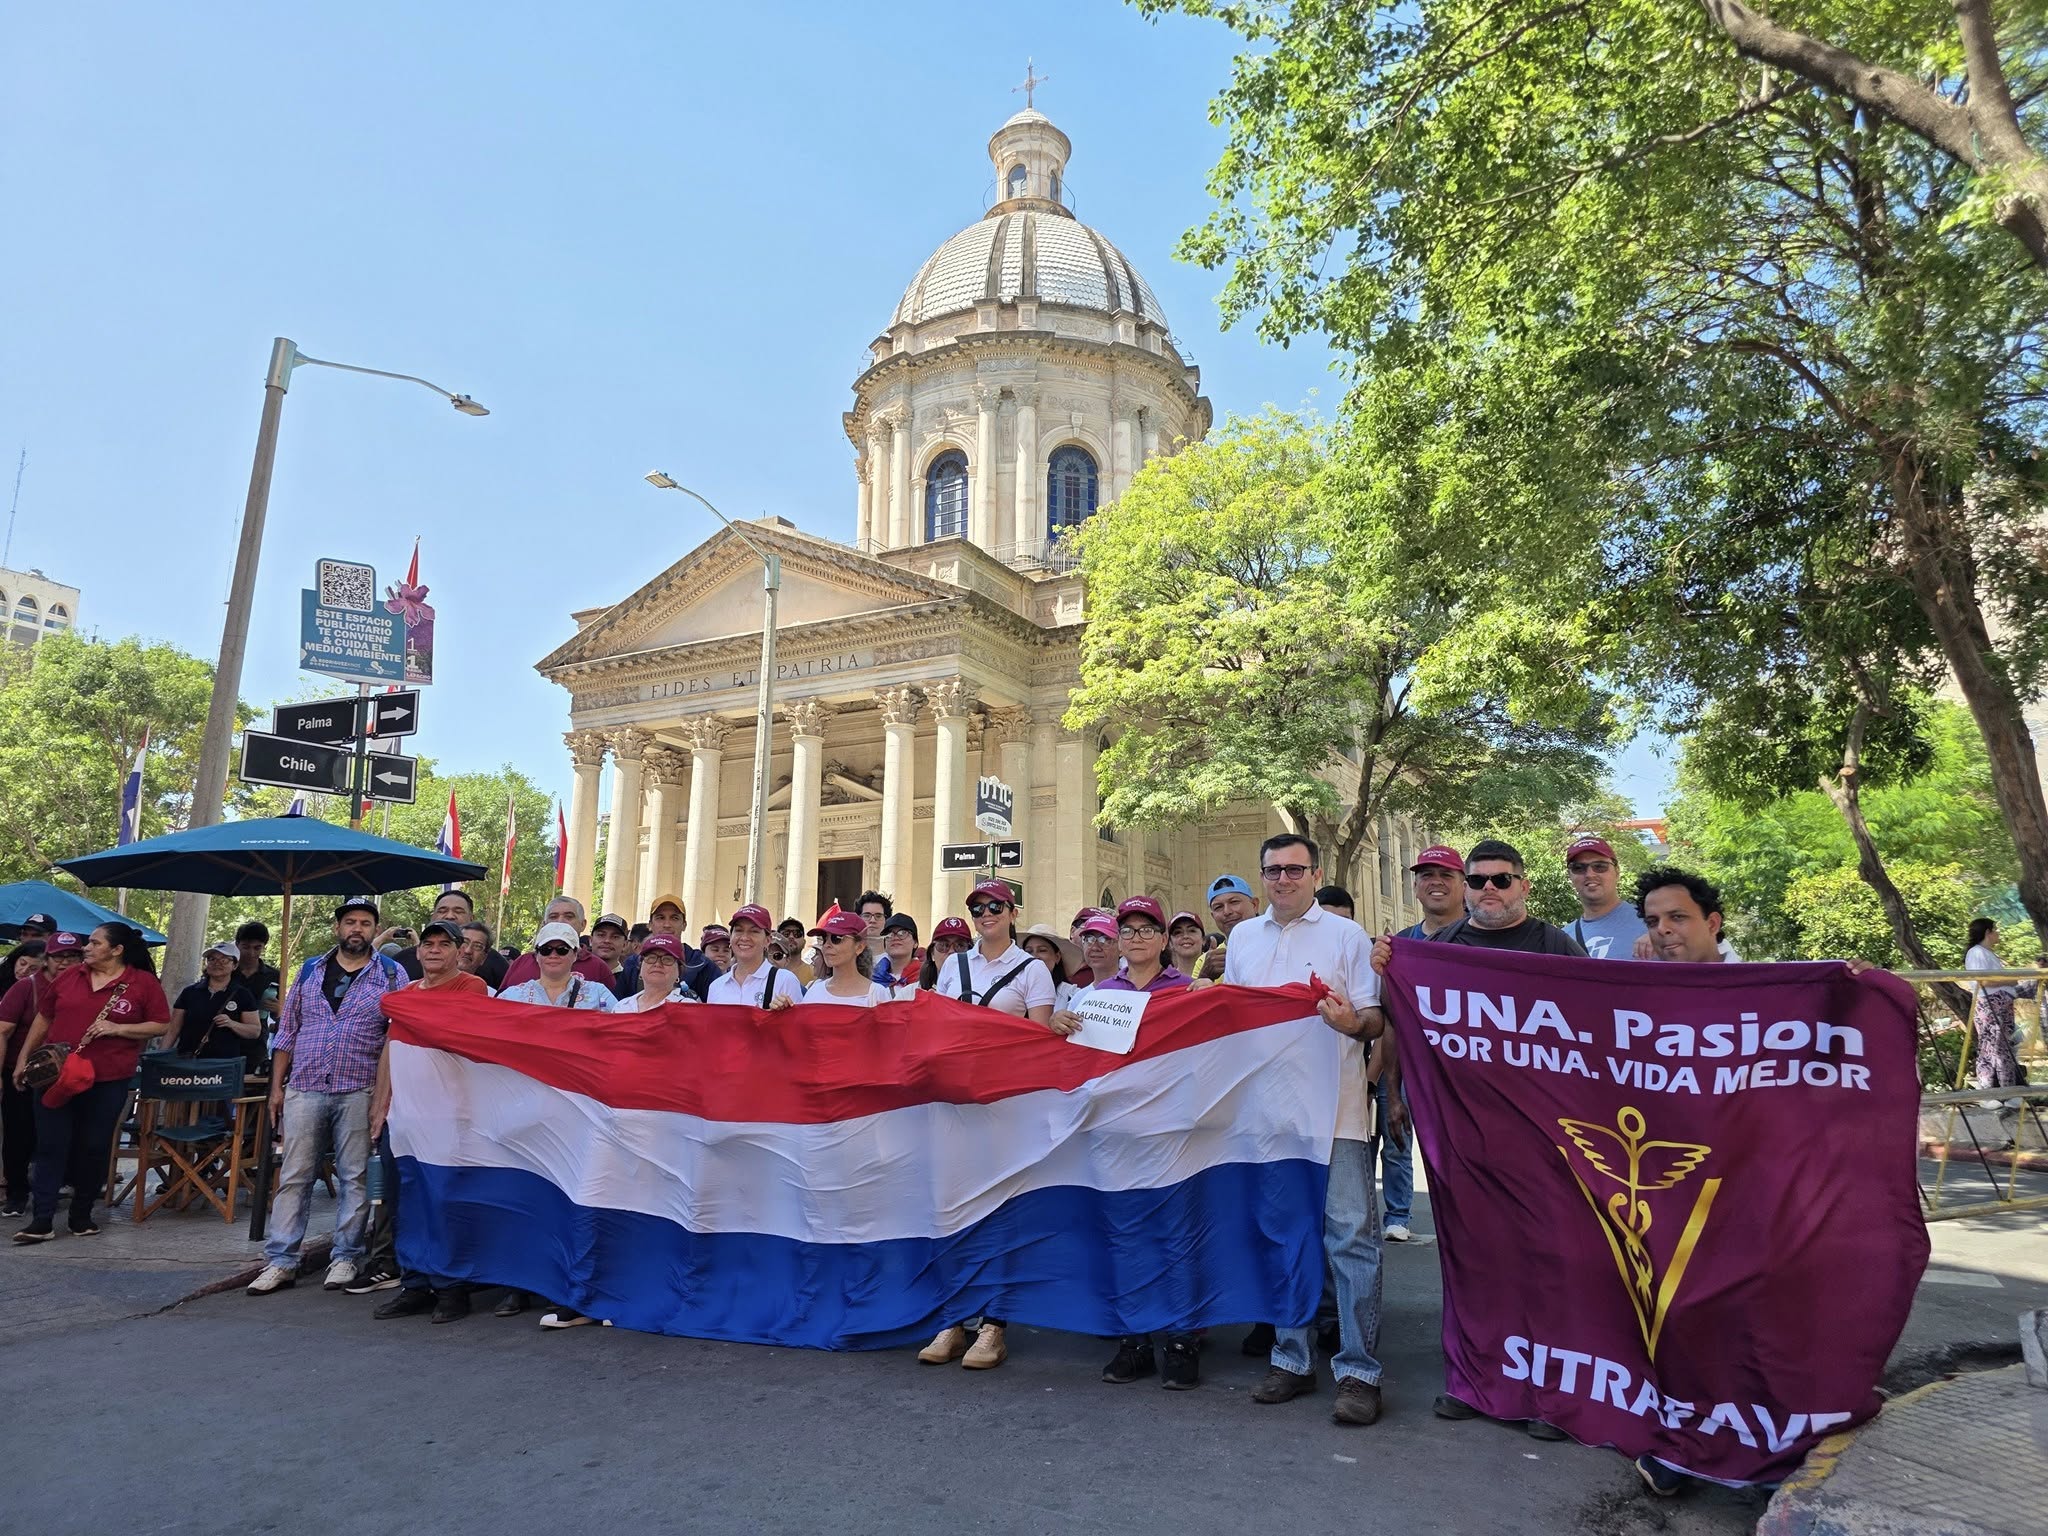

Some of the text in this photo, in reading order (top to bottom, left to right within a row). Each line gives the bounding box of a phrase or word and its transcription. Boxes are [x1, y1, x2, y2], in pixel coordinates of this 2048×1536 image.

[315, 608, 393, 627] ESTE ESPACIO
[315, 617, 393, 637] PUBLICITARIO
[318, 626, 390, 645] TE CONVIENE
[322, 636, 385, 653] & CUIDA EL
[305, 641, 402, 663] MEDIO AMBIENTE
[651, 653, 859, 698] FIDES ET PATRIA
[297, 716, 332, 730] Palma
[279, 755, 316, 773] Chile
[954, 852, 975, 861] Palma
[1112, 1019, 1132, 1029] YA!!!
[1415, 984, 1863, 1058] UNA. Pasion
[1423, 1029, 1871, 1095] POR UNA. VIDA MEJOR
[160, 1074, 222, 1086] ueno bank
